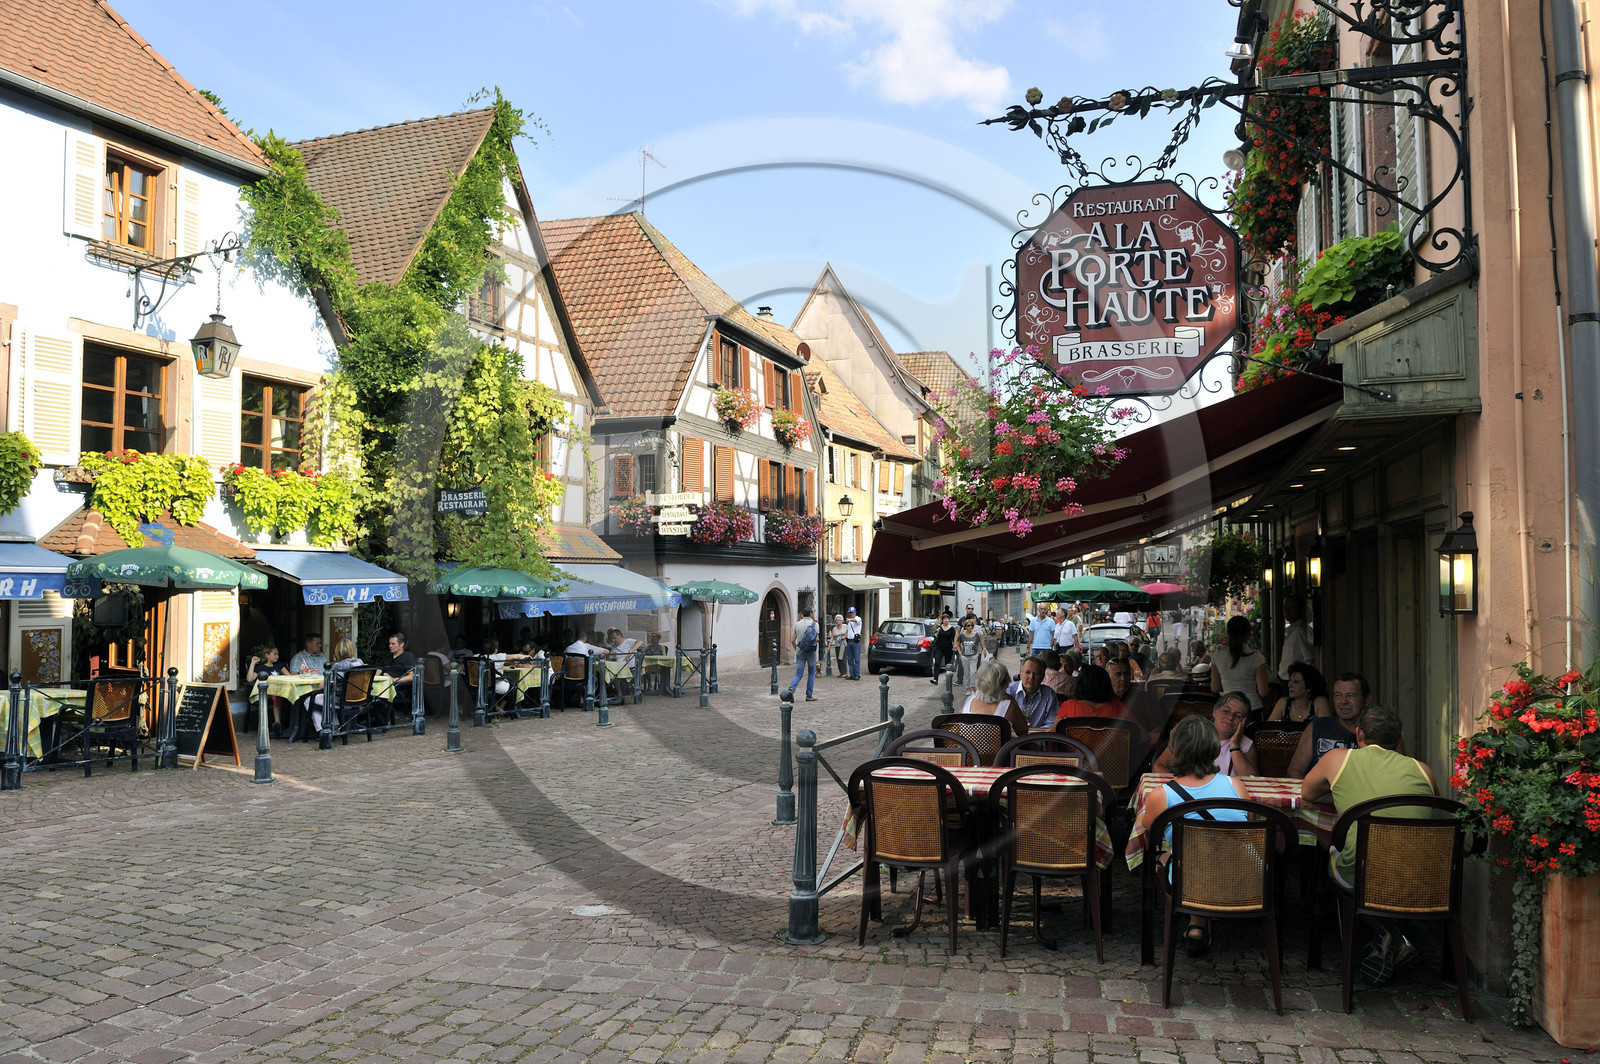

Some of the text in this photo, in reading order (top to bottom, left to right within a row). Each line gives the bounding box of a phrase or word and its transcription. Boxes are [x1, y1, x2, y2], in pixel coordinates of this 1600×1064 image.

[1040, 247, 1190, 292] PORTE
[1064, 273, 1214, 327] HAUTE
[1069, 342, 1184, 361] BRASSERIE
[584, 600, 637, 612] HASSENFORDER
